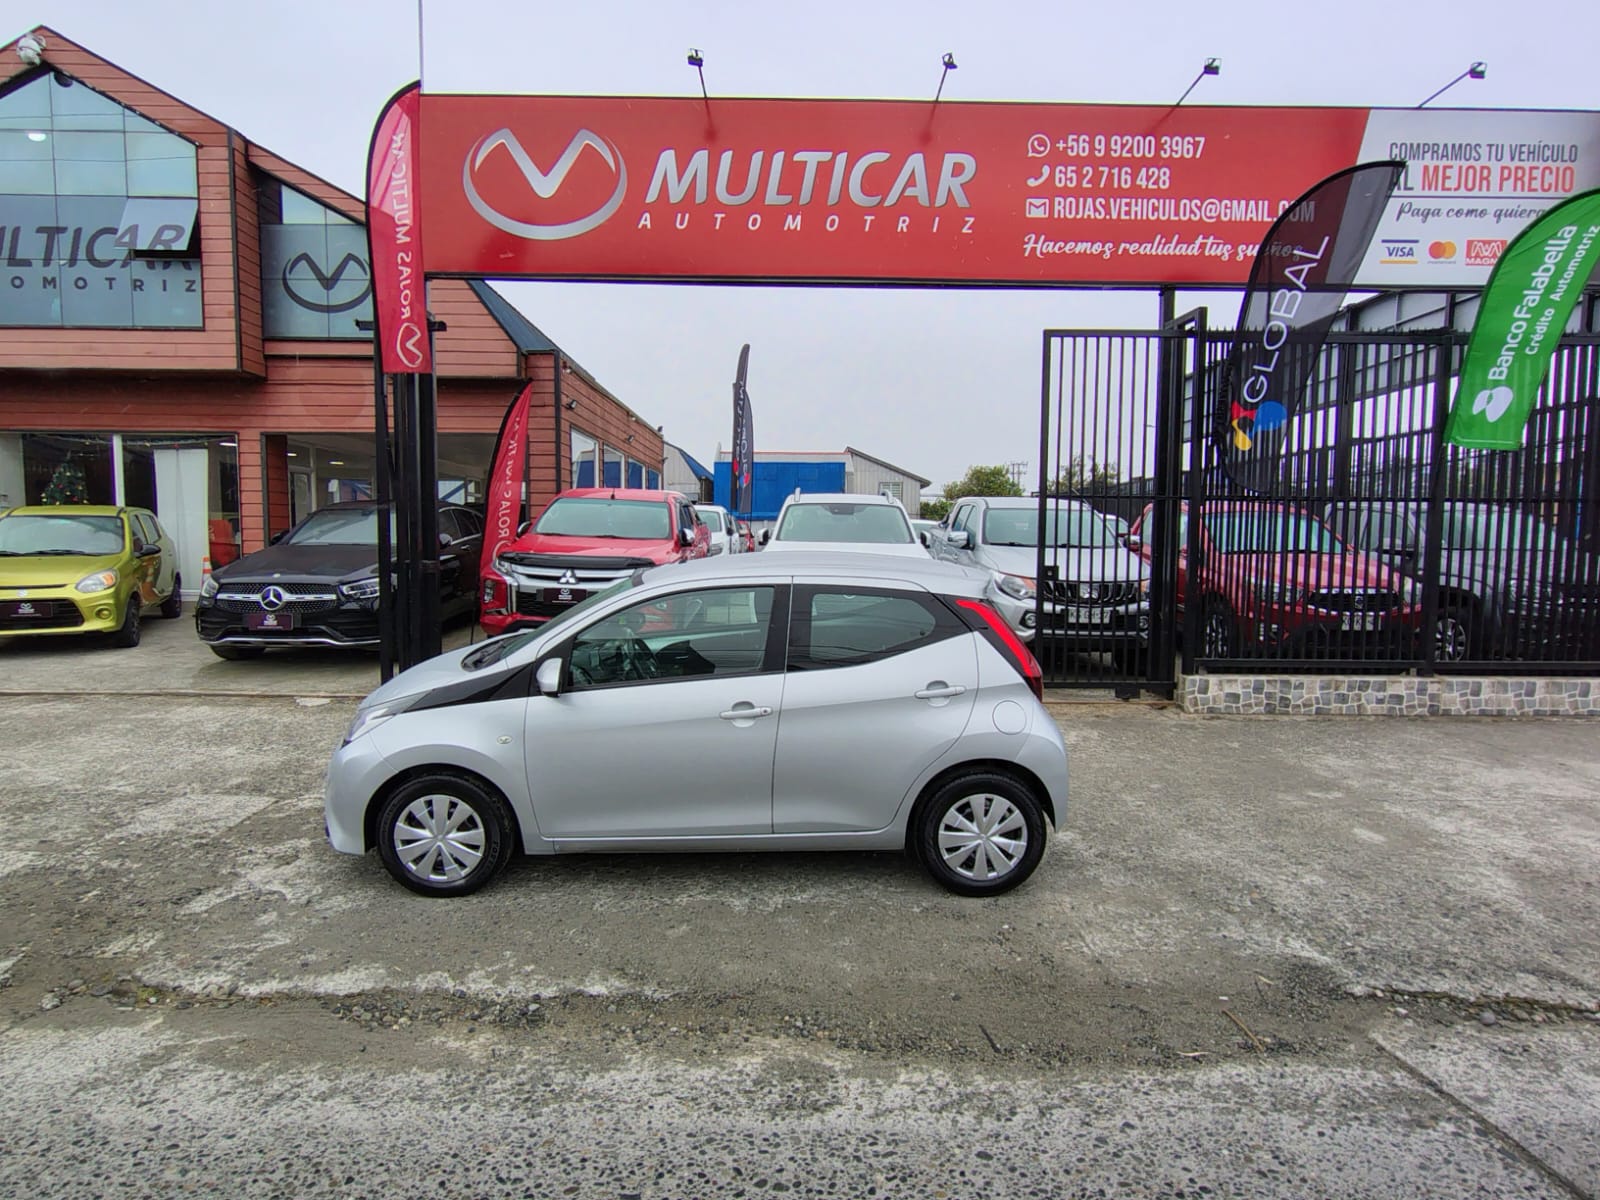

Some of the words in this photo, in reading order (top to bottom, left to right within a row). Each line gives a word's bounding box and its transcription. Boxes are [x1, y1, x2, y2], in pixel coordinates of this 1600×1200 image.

[1055, 135, 1089, 157] +56
[1094, 135, 1106, 157] 9
[1110, 135, 1155, 158] 9200
[1160, 136, 1206, 159] 3967
[1389, 142, 1482, 162] COMPRAMOS
[1486, 143, 1505, 162] TU
[1508, 140, 1578, 163] VEHÍCULO
[645, 148, 977, 208] MULTICAR
[1054, 166, 1077, 188] 65
[1082, 166, 1093, 188] 2
[1099, 166, 1132, 188] 716
[1136, 167, 1171, 189] 428
[1421, 164, 1491, 192] MEJOR
[1498, 165, 1576, 193] PRECIO
[638, 212, 976, 233] AUTOMOTRIZ
[1396, 201, 1441, 224] Paga
[1446, 208, 1489, 218] como
[1024, 234, 1115, 259] Hacemos
[1117, 234, 1202, 257] realidad
[1200, 236, 1233, 261] tus
[1386, 246, 1415, 257] VISA
[1525, 308, 1555, 355] Crédito
[1550, 225, 1600, 302] Automotriz
[1243, 236, 1330, 403] GLOBAL
